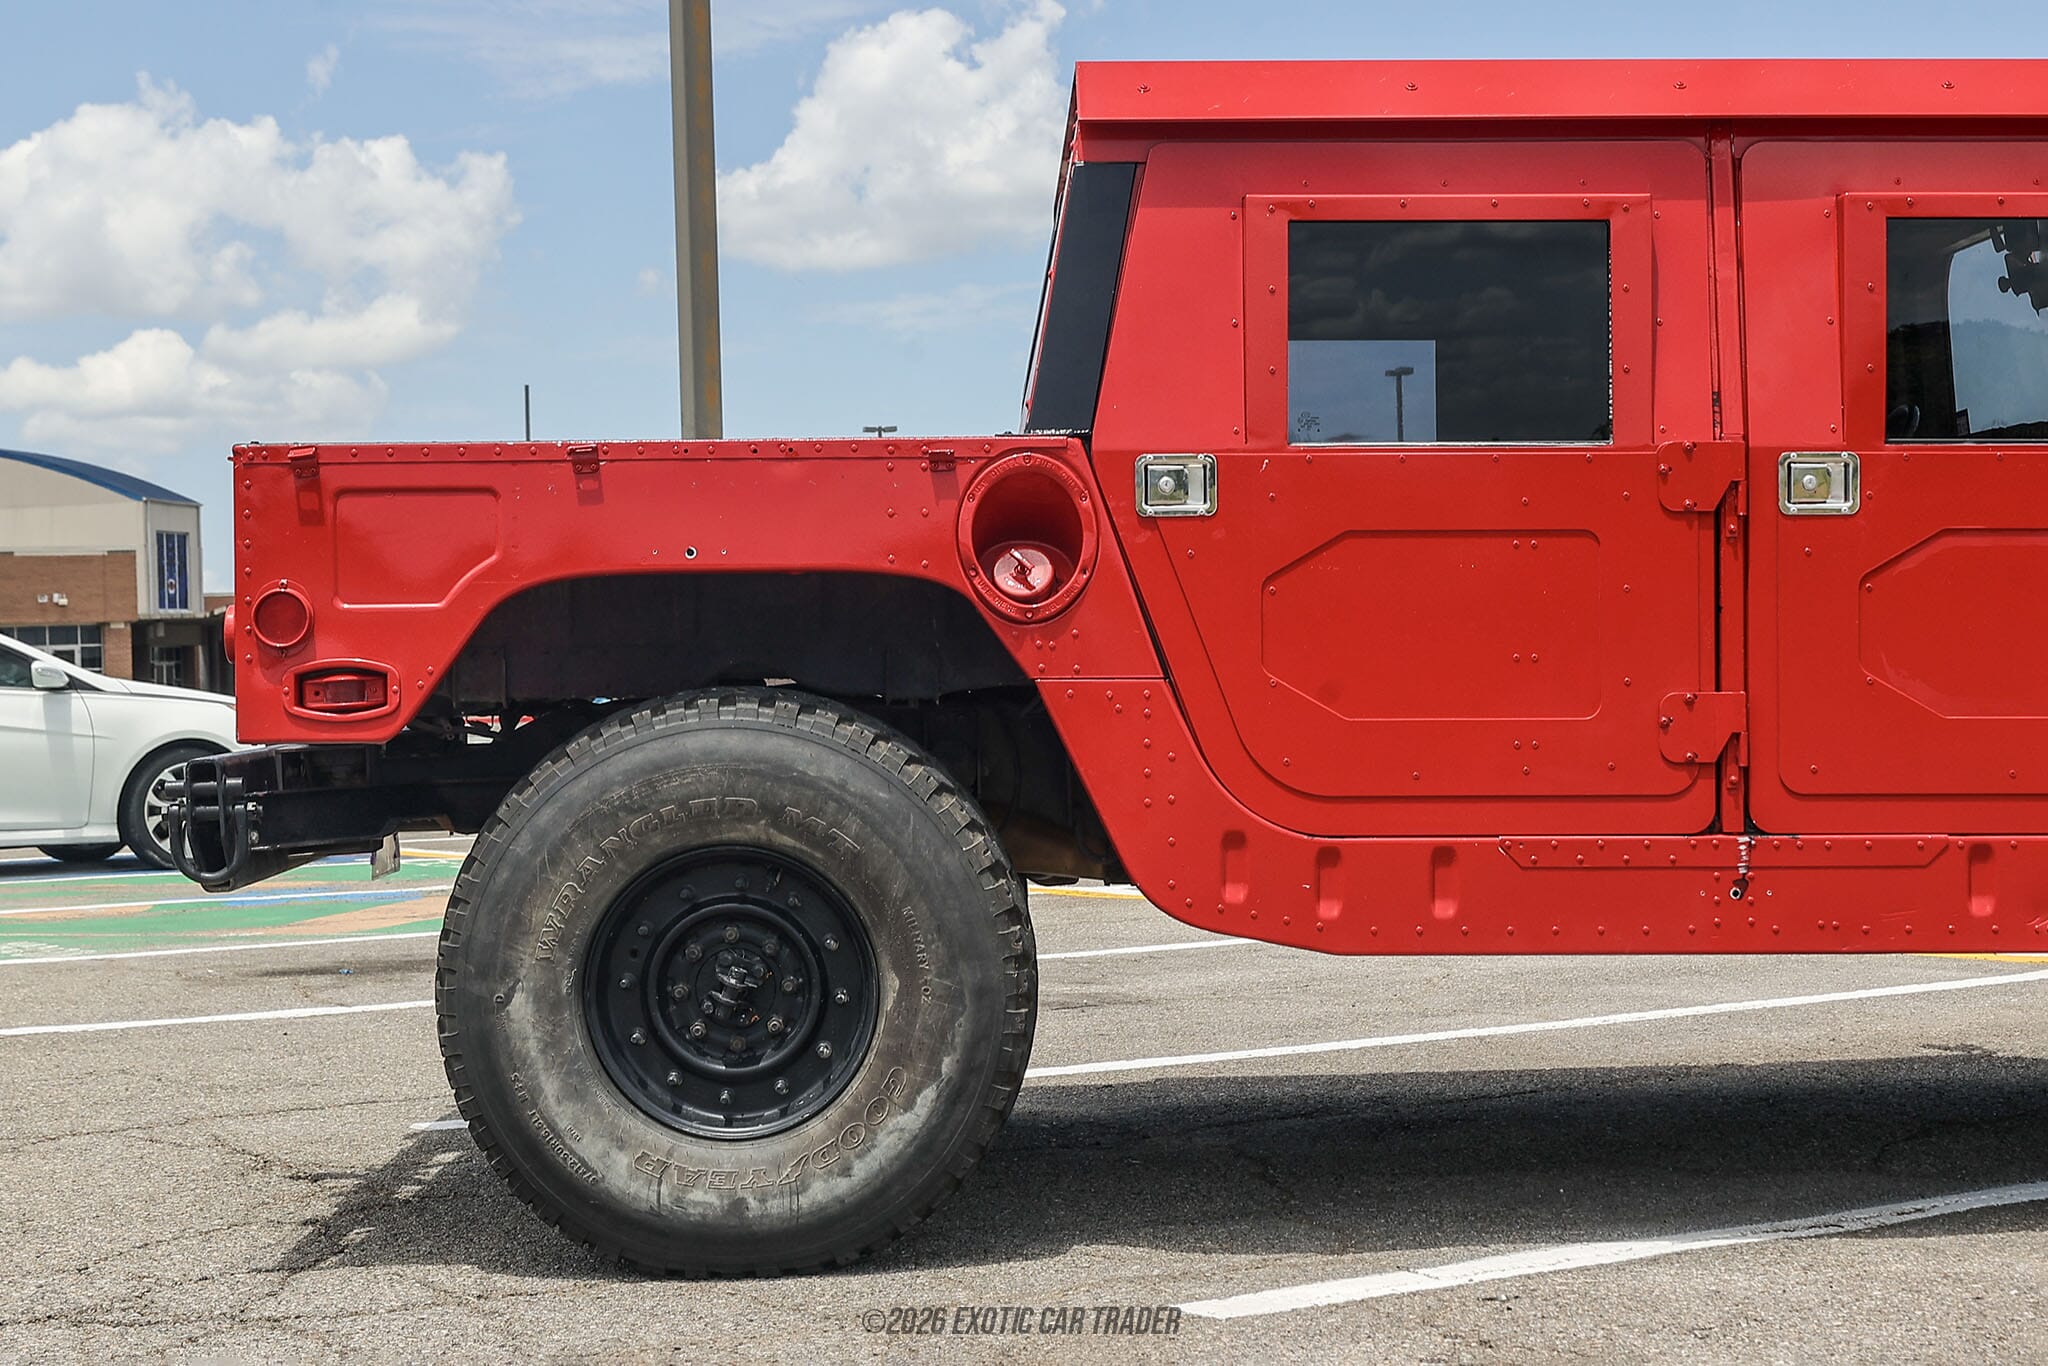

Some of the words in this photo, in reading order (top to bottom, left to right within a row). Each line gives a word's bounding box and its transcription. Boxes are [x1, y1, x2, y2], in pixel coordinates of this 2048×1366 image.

[534, 796, 759, 962] WRANGLER
[783, 805, 861, 851] MT
[633, 1066, 908, 1191] GOODYEAR
